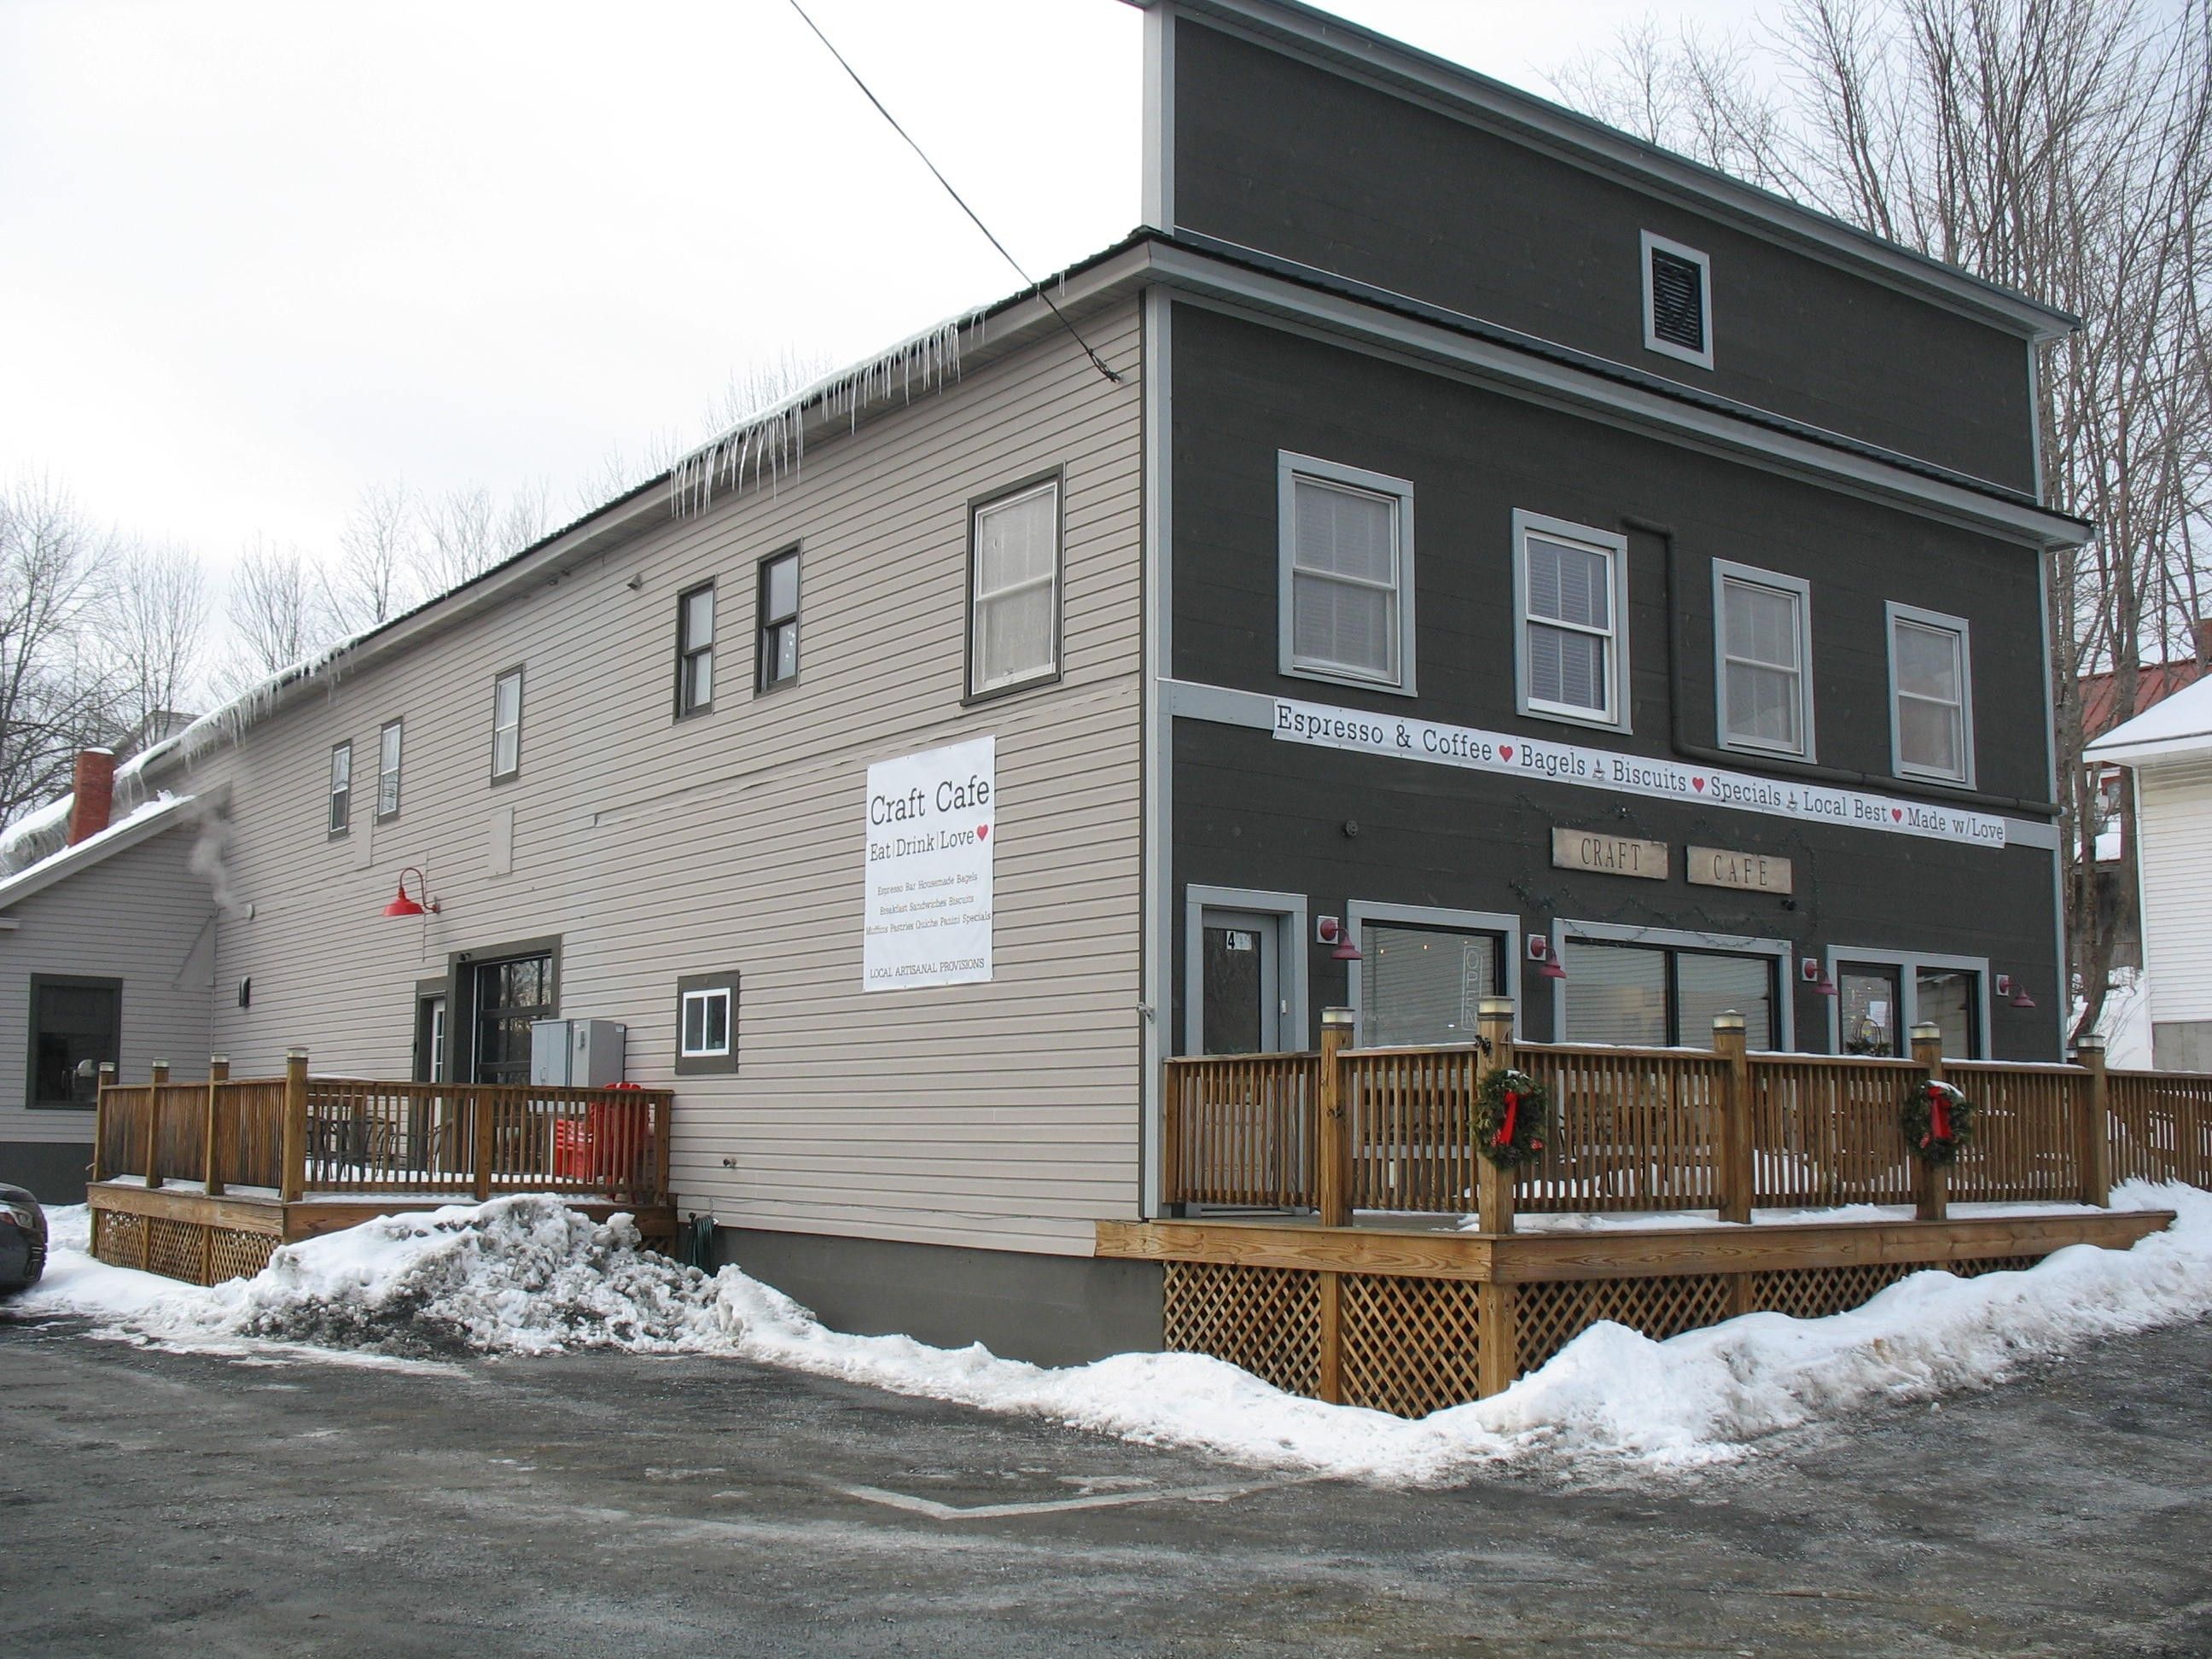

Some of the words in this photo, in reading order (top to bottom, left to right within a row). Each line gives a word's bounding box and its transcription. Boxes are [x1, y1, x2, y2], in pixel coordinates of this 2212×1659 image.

[1278, 705, 1383, 744] Espresso
[1396, 724, 1412, 748] &
[1423, 729, 1492, 760] Coffee
[1521, 744, 1586, 777] Bagels
[1612, 760, 1686, 792] Biscuits
[1711, 776, 1781, 806] Specials
[1803, 791, 1847, 818] Local
[1854, 798, 1887, 823] Best
[1907, 807, 1946, 831] Made
[1952, 817, 2004, 841] w/Love
[870, 787, 925, 825] Craft
[936, 775, 990, 812] Cafe
[1581, 837, 1641, 871] CRAFT
[1714, 854, 1767, 886] CAFE
[905, 882, 916, 891] Bar
[957, 872, 978, 885] Bagels
[910, 899, 946, 911] Sandwiches
[949, 894, 974, 906] Biscuits
[890, 922, 914, 933] Pastries
[940, 915, 960, 926] Panini
[963, 911, 991, 925] Specials
[870, 968, 893, 979] LOCAL
[895, 962, 937, 976] ARTISANAL
[940, 958, 985, 972] PROVISIONS
[1466, 950, 1479, 1026] OPEN
